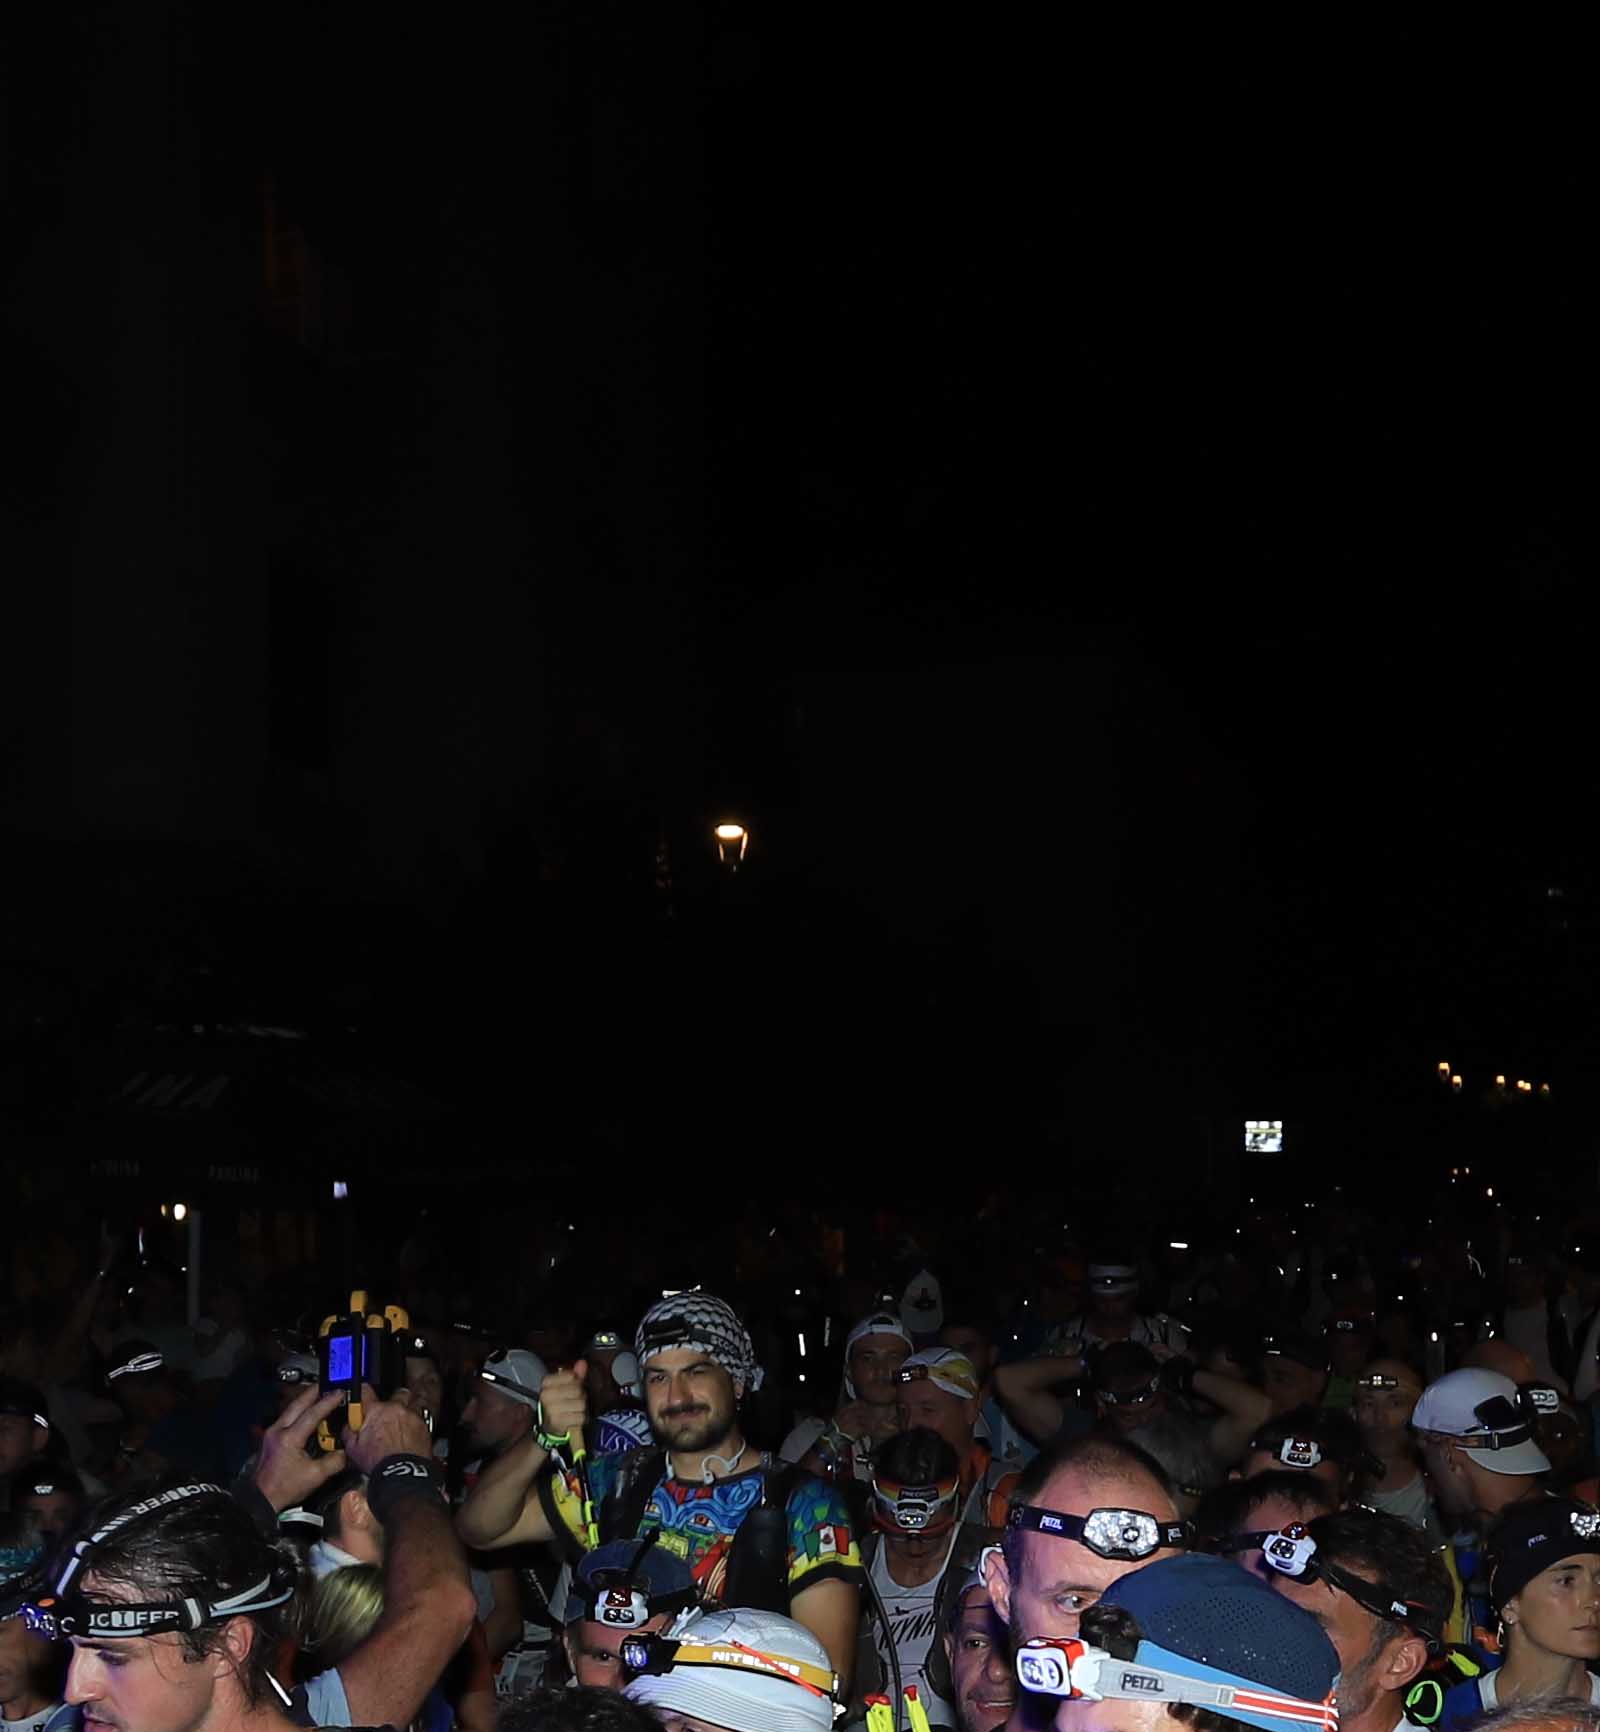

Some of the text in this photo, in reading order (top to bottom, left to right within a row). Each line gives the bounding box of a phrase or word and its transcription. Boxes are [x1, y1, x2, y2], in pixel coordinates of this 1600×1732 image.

[1039, 1514, 1065, 1531] PETZL
[87, 1609, 180, 1628] UCIFER
[1121, 1674, 1164, 1692] PETZL
